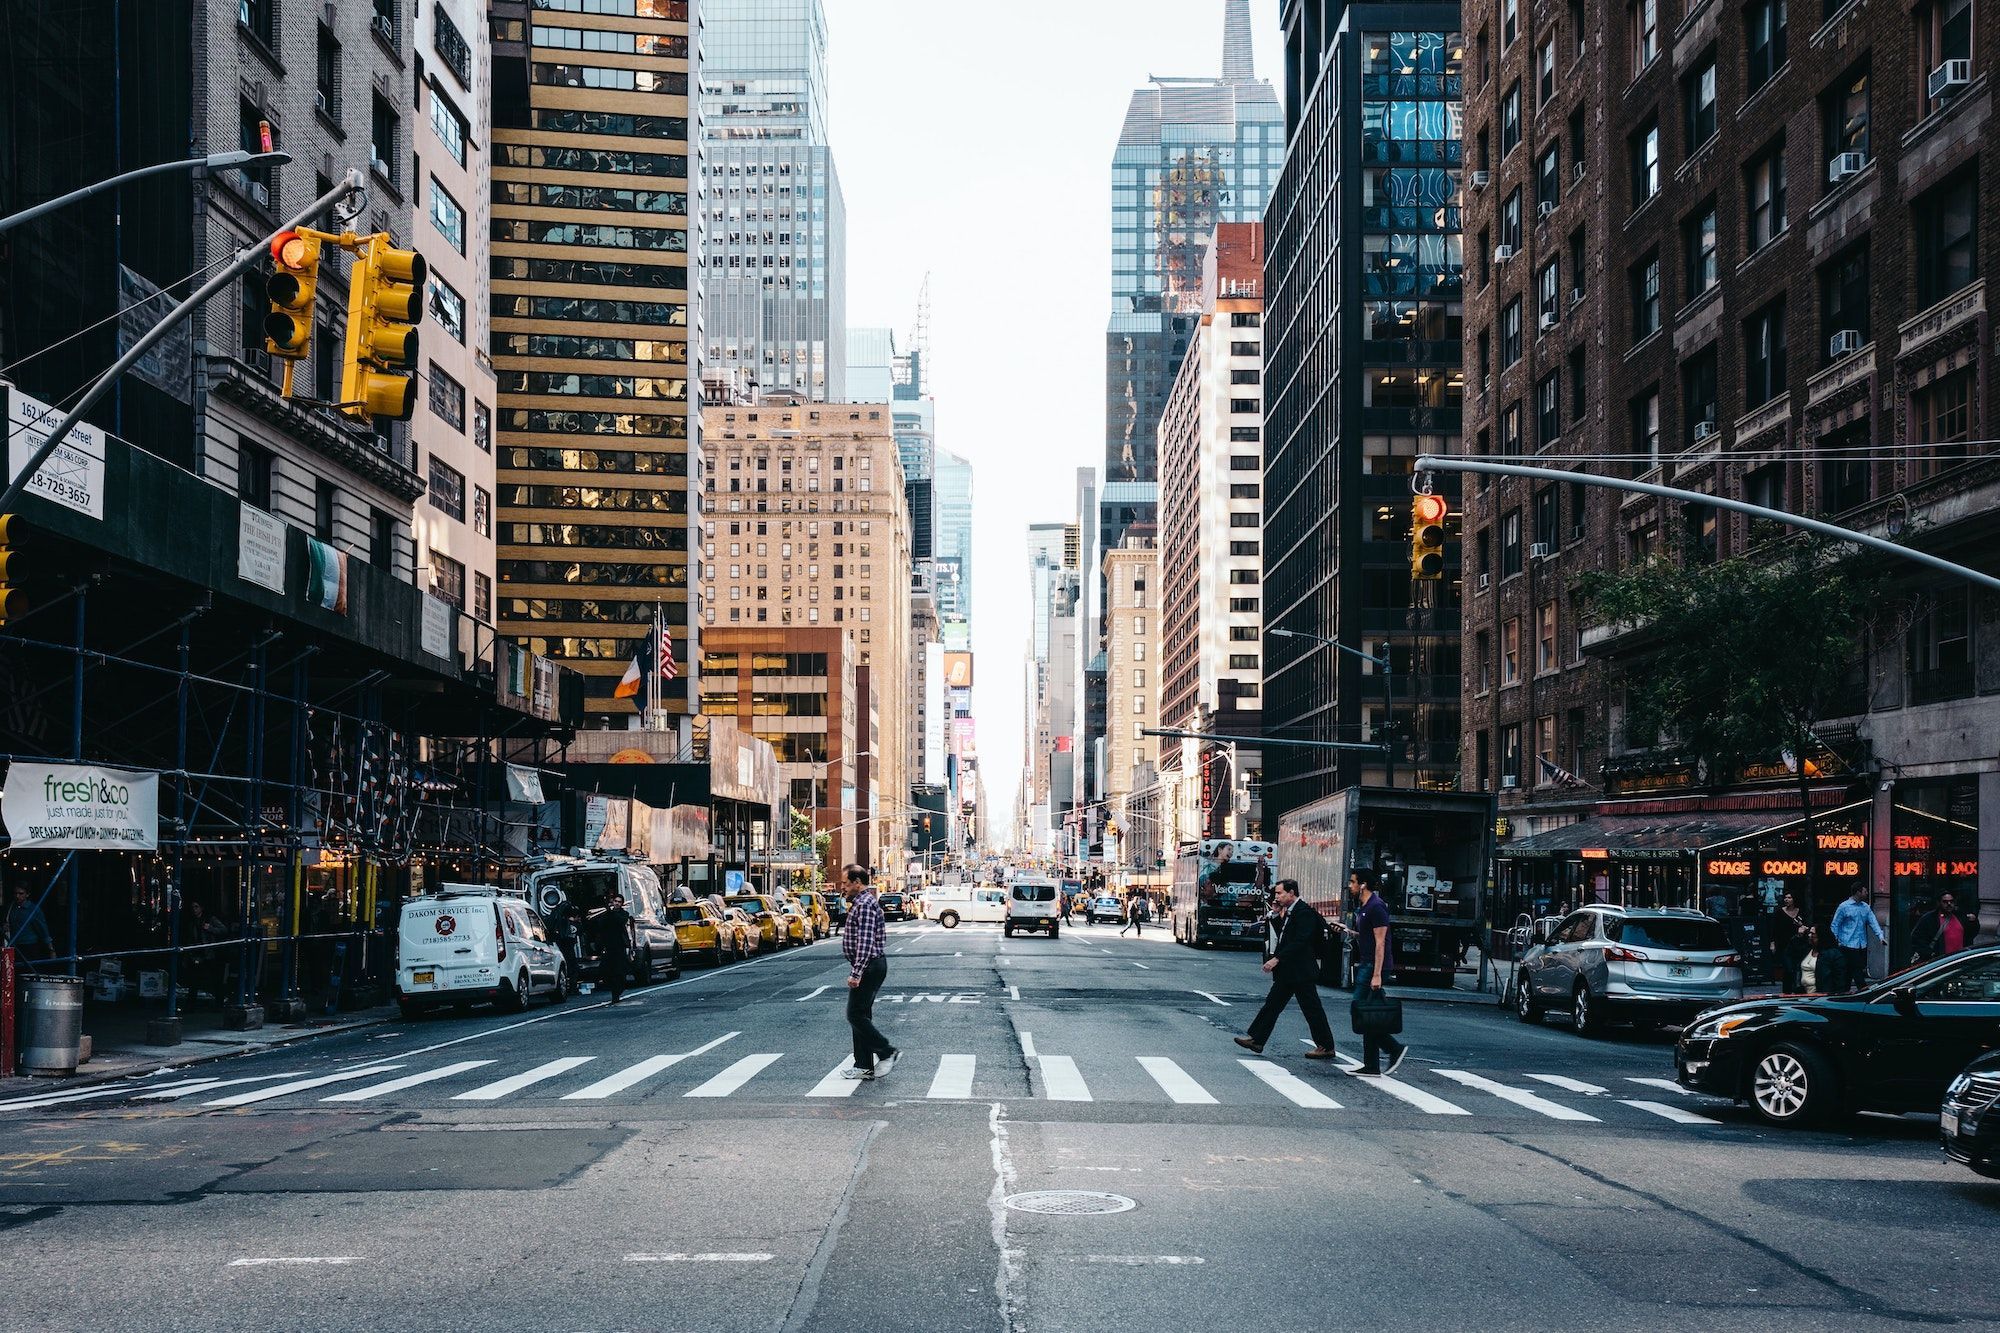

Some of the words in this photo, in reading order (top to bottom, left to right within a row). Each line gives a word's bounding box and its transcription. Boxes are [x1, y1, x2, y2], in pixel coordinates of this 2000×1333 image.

[22, 402, 37, 419] 162
[39, 409, 58, 430] West
[70, 426, 92, 446] Street
[31, 472, 91, 506] 18-729-3657
[44, 775, 129, 805] fresh&co
[29, 826, 72, 840] BREAKFAST
[1816, 835, 1865, 849] TAVERN
[1709, 861, 1750, 875] STAGE
[1763, 861, 1806, 875] COACH
[1825, 861, 1859, 875] PUB
[408, 909, 436, 919] DAKOM
[438, 907, 470, 915] SERVICE
[422, 934, 471, 945] (718)585-7733
